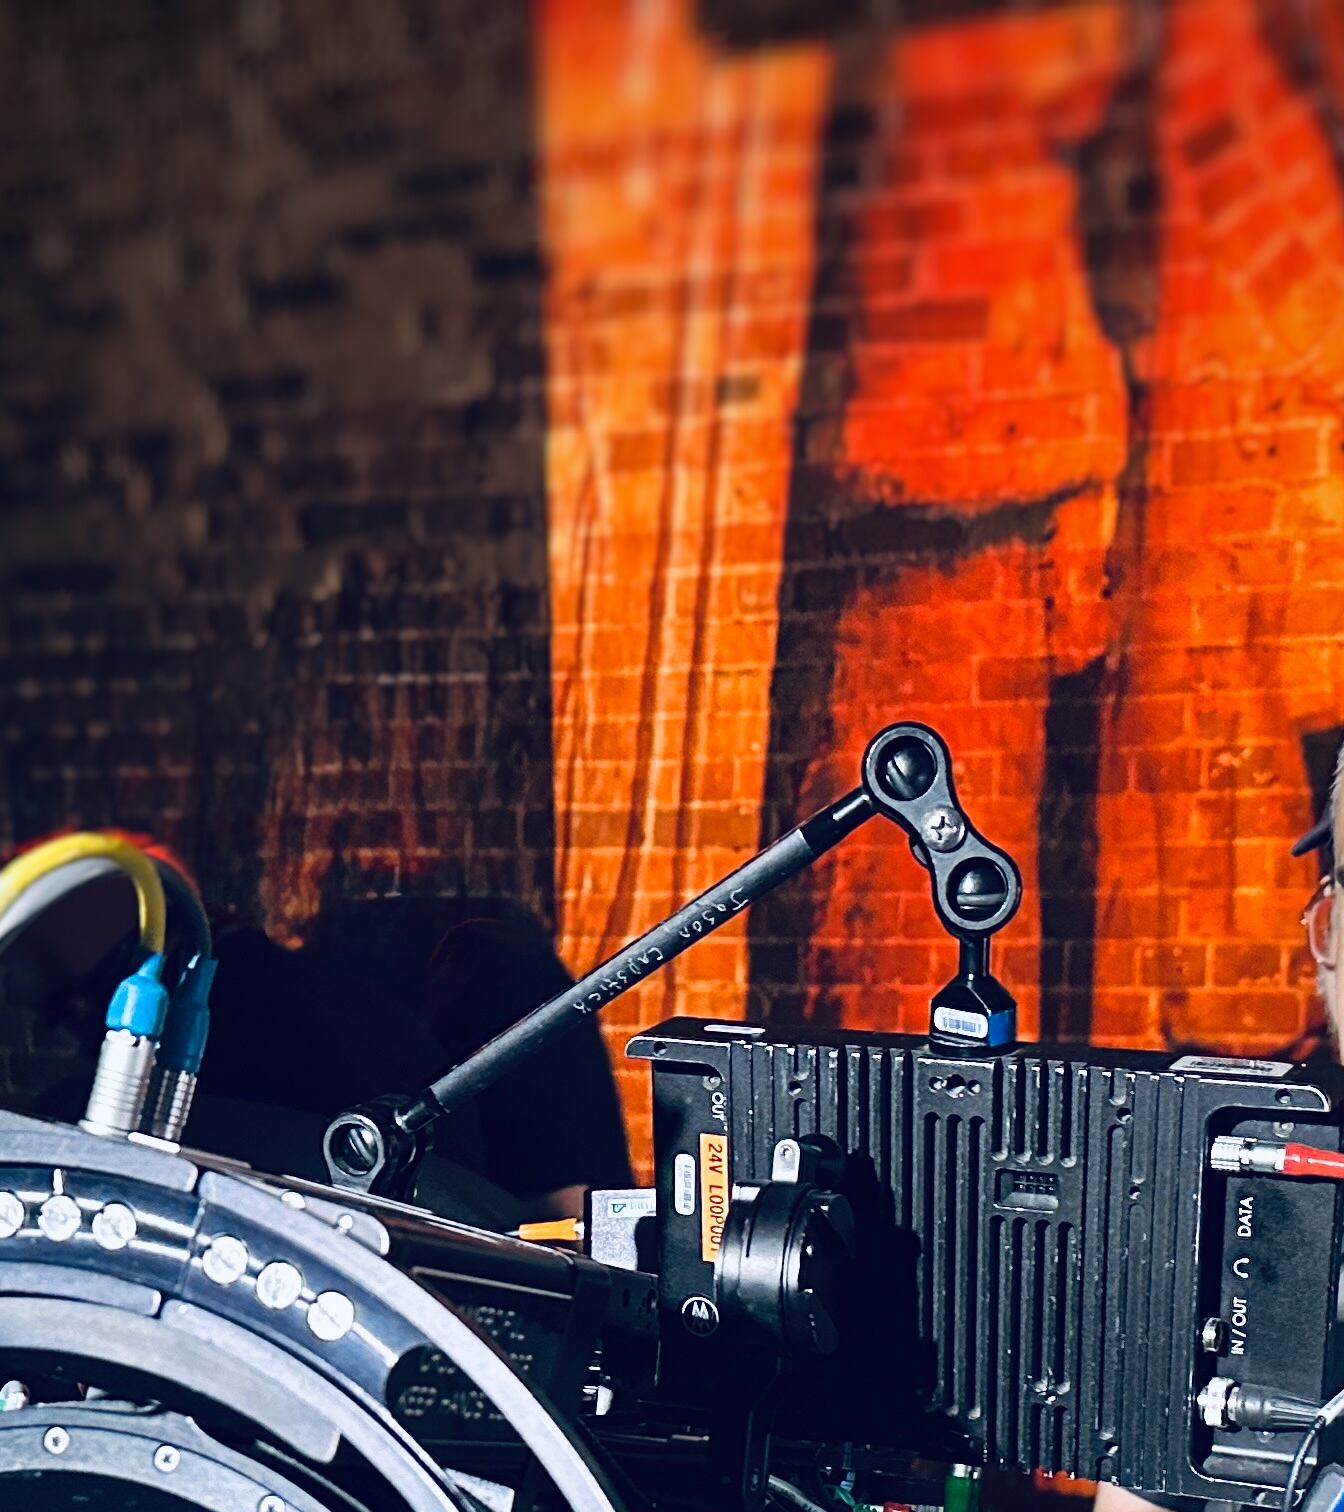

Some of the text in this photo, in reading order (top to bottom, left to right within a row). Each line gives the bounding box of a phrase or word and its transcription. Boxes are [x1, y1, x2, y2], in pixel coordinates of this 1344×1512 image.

[679, 888, 750, 939] Jason
[711, 1091, 726, 1121] OUT
[708, 1143, 724, 1176] 24V
[1237, 1196, 1255, 1238] DATA
